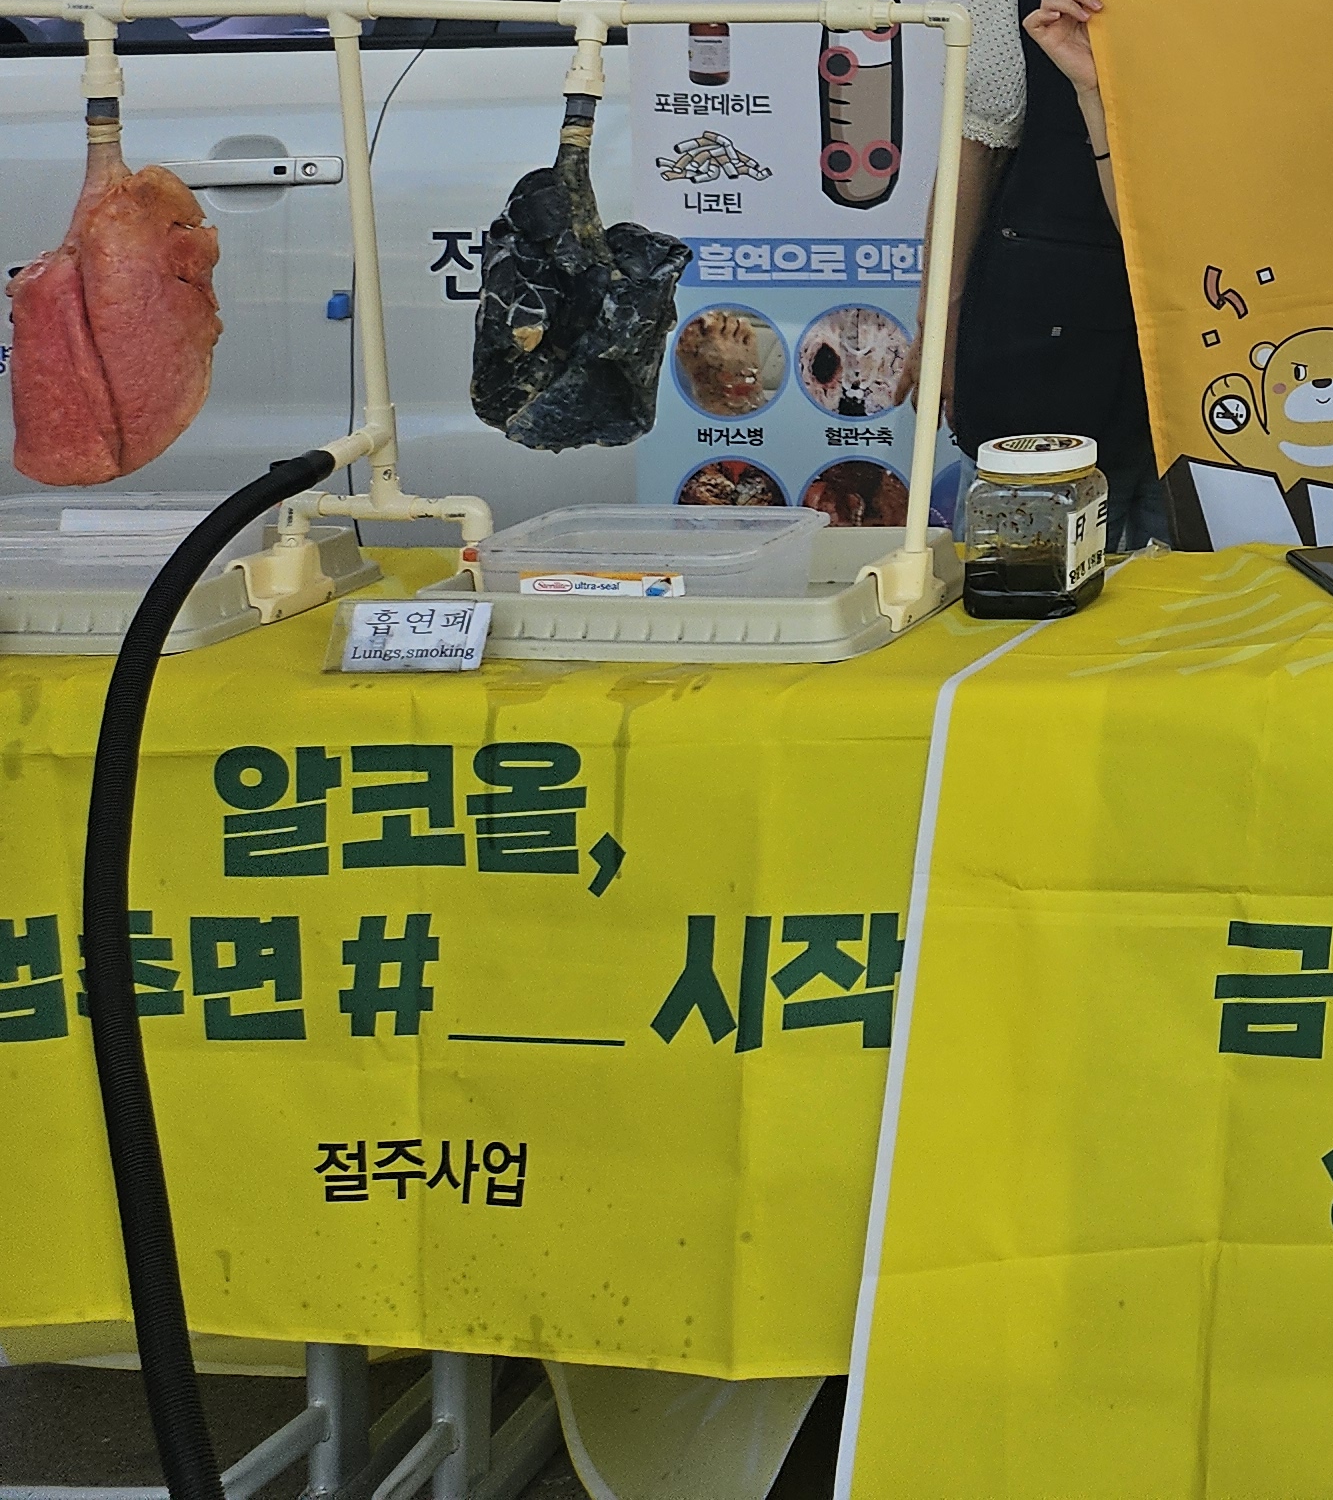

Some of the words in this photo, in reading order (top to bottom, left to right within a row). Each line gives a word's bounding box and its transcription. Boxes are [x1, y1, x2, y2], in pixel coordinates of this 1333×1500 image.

[654, 93, 772, 116] 포름알데히드
[684, 192, 742, 214] 니코틴
[698, 243, 848, 281] 흡연으로
[697, 427, 763, 446] 버거스병
[825, 427, 894, 446] 혈관수축
[213, 741, 626, 898] 알코올,
[315, 1138, 529, 1207] 절주사업
